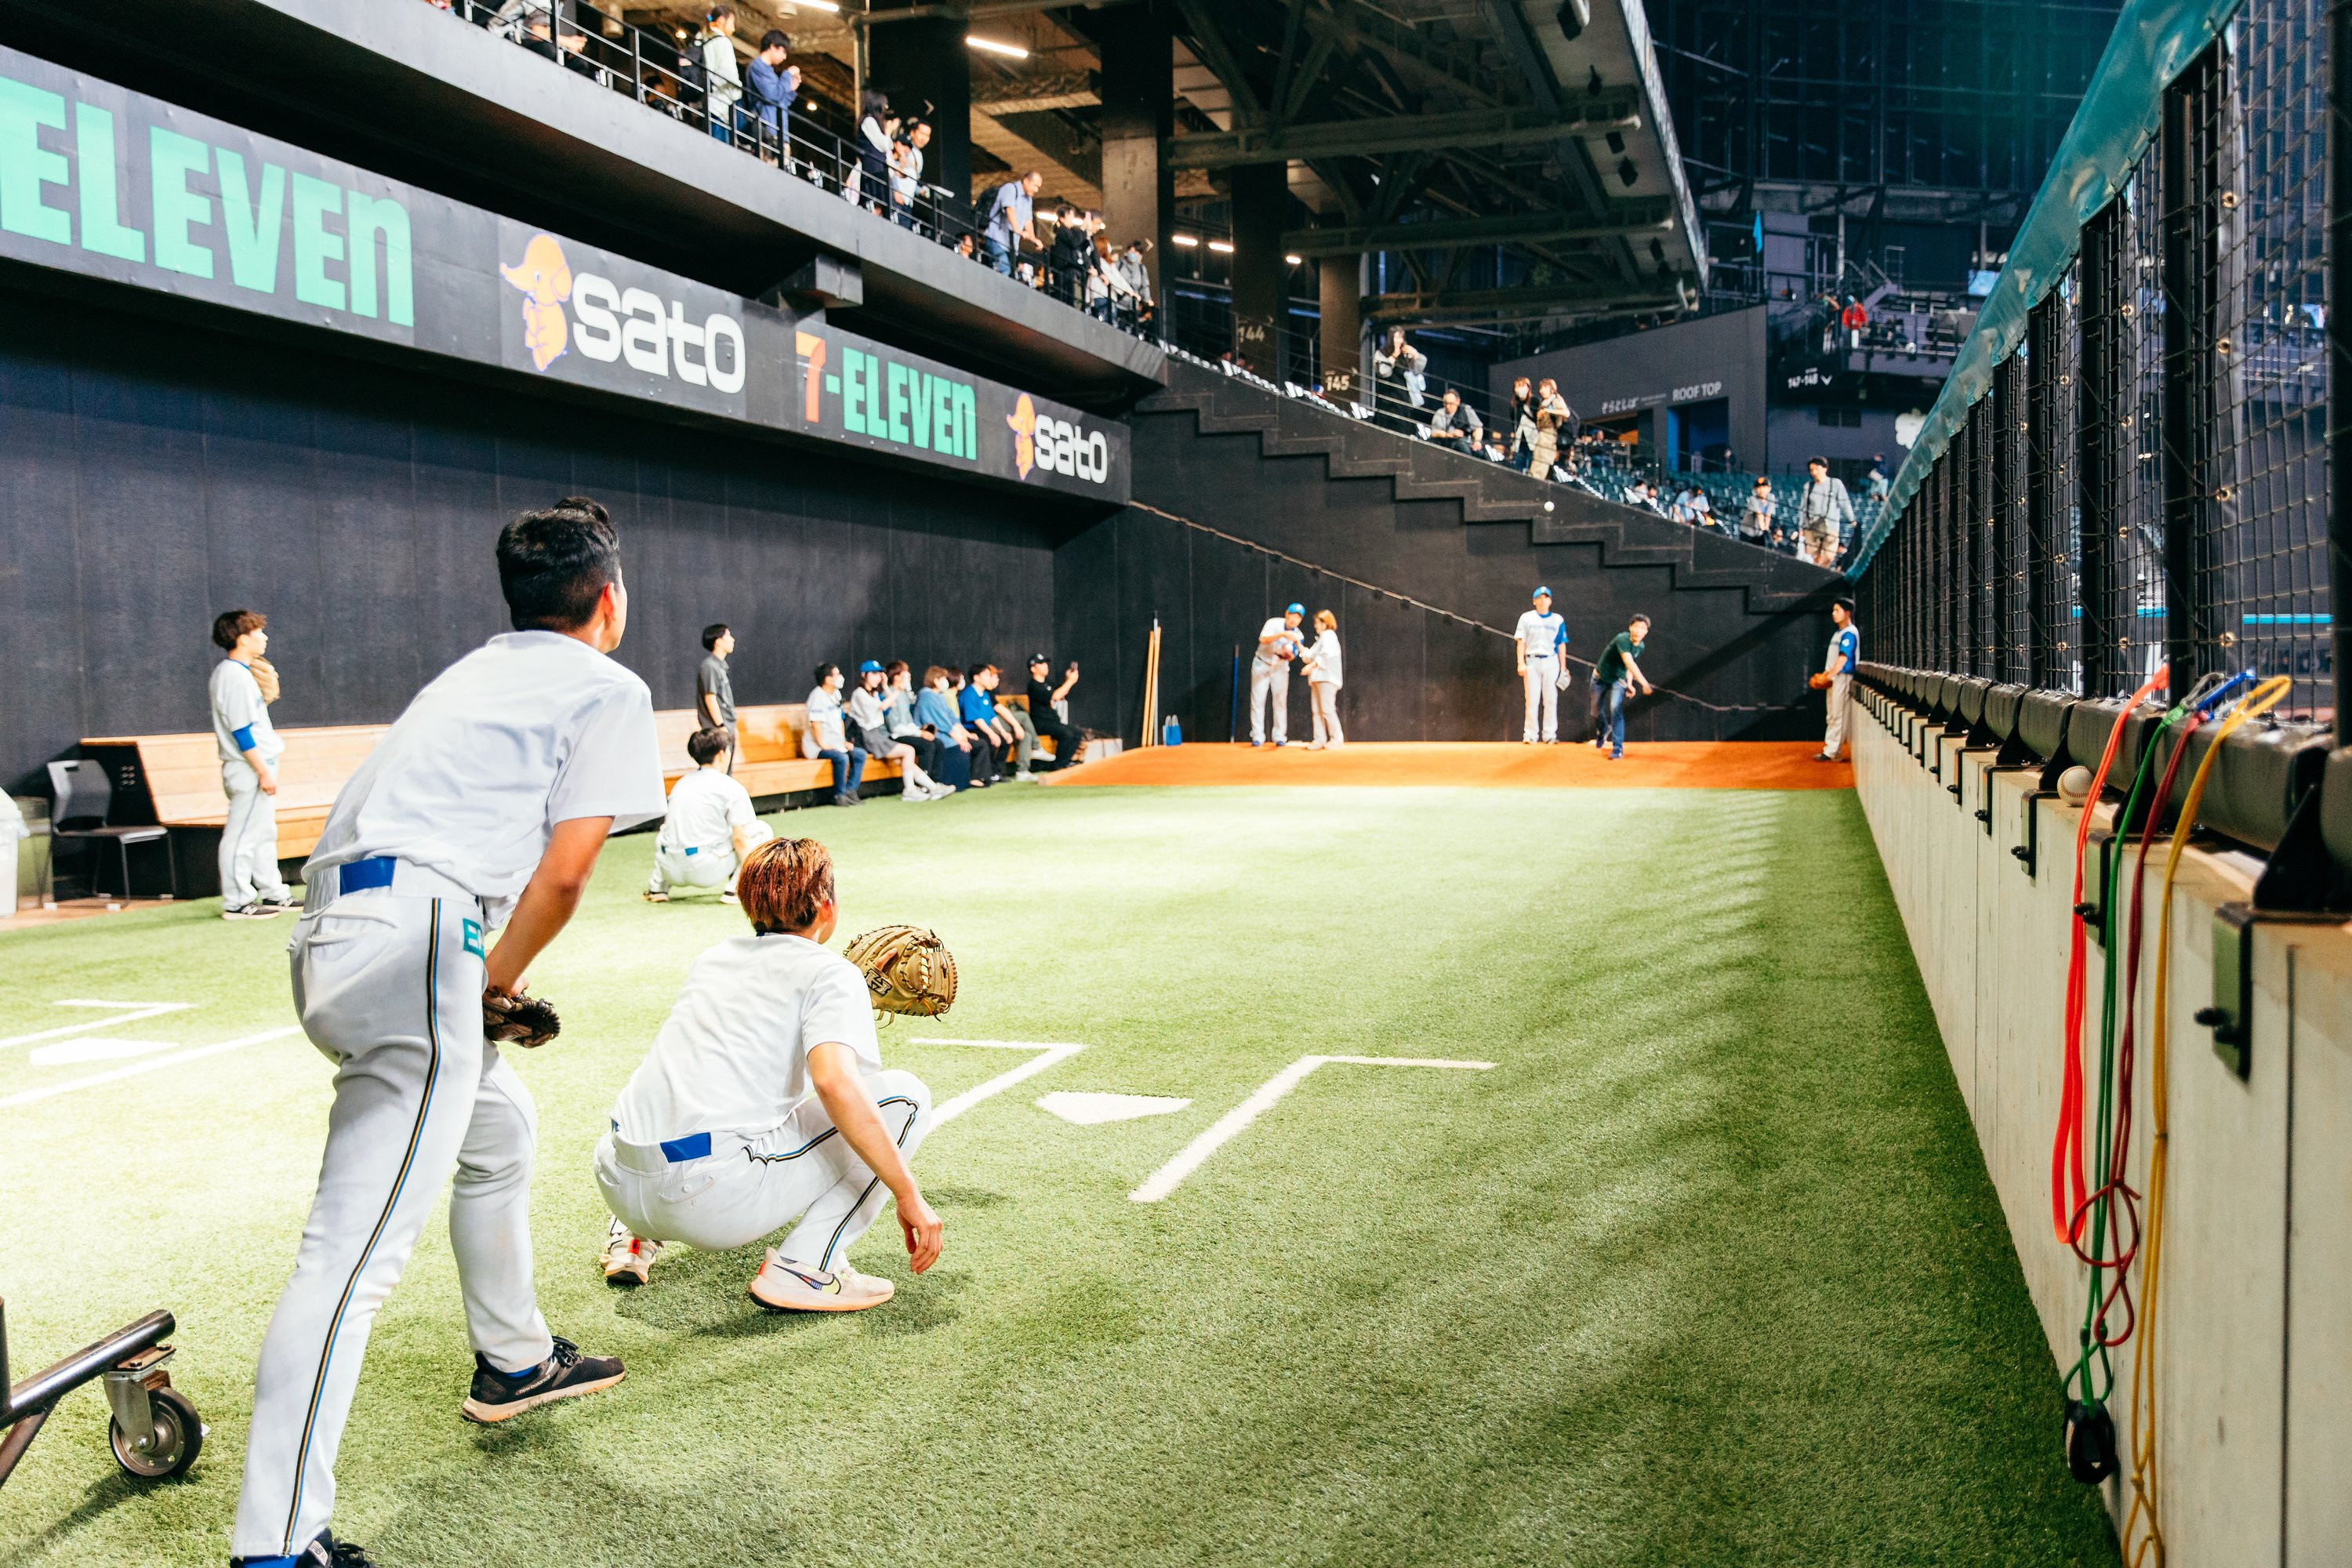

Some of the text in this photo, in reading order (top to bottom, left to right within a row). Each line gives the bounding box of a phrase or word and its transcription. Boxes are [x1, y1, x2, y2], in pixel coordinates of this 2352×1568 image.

[572, 271, 746, 394] sato
[1325, 375, 1350, 391] 145
[1672, 385, 1700, 401] ROOF
[1701, 381, 1722, 397] TOP
[1034, 413, 1108, 484] sato
